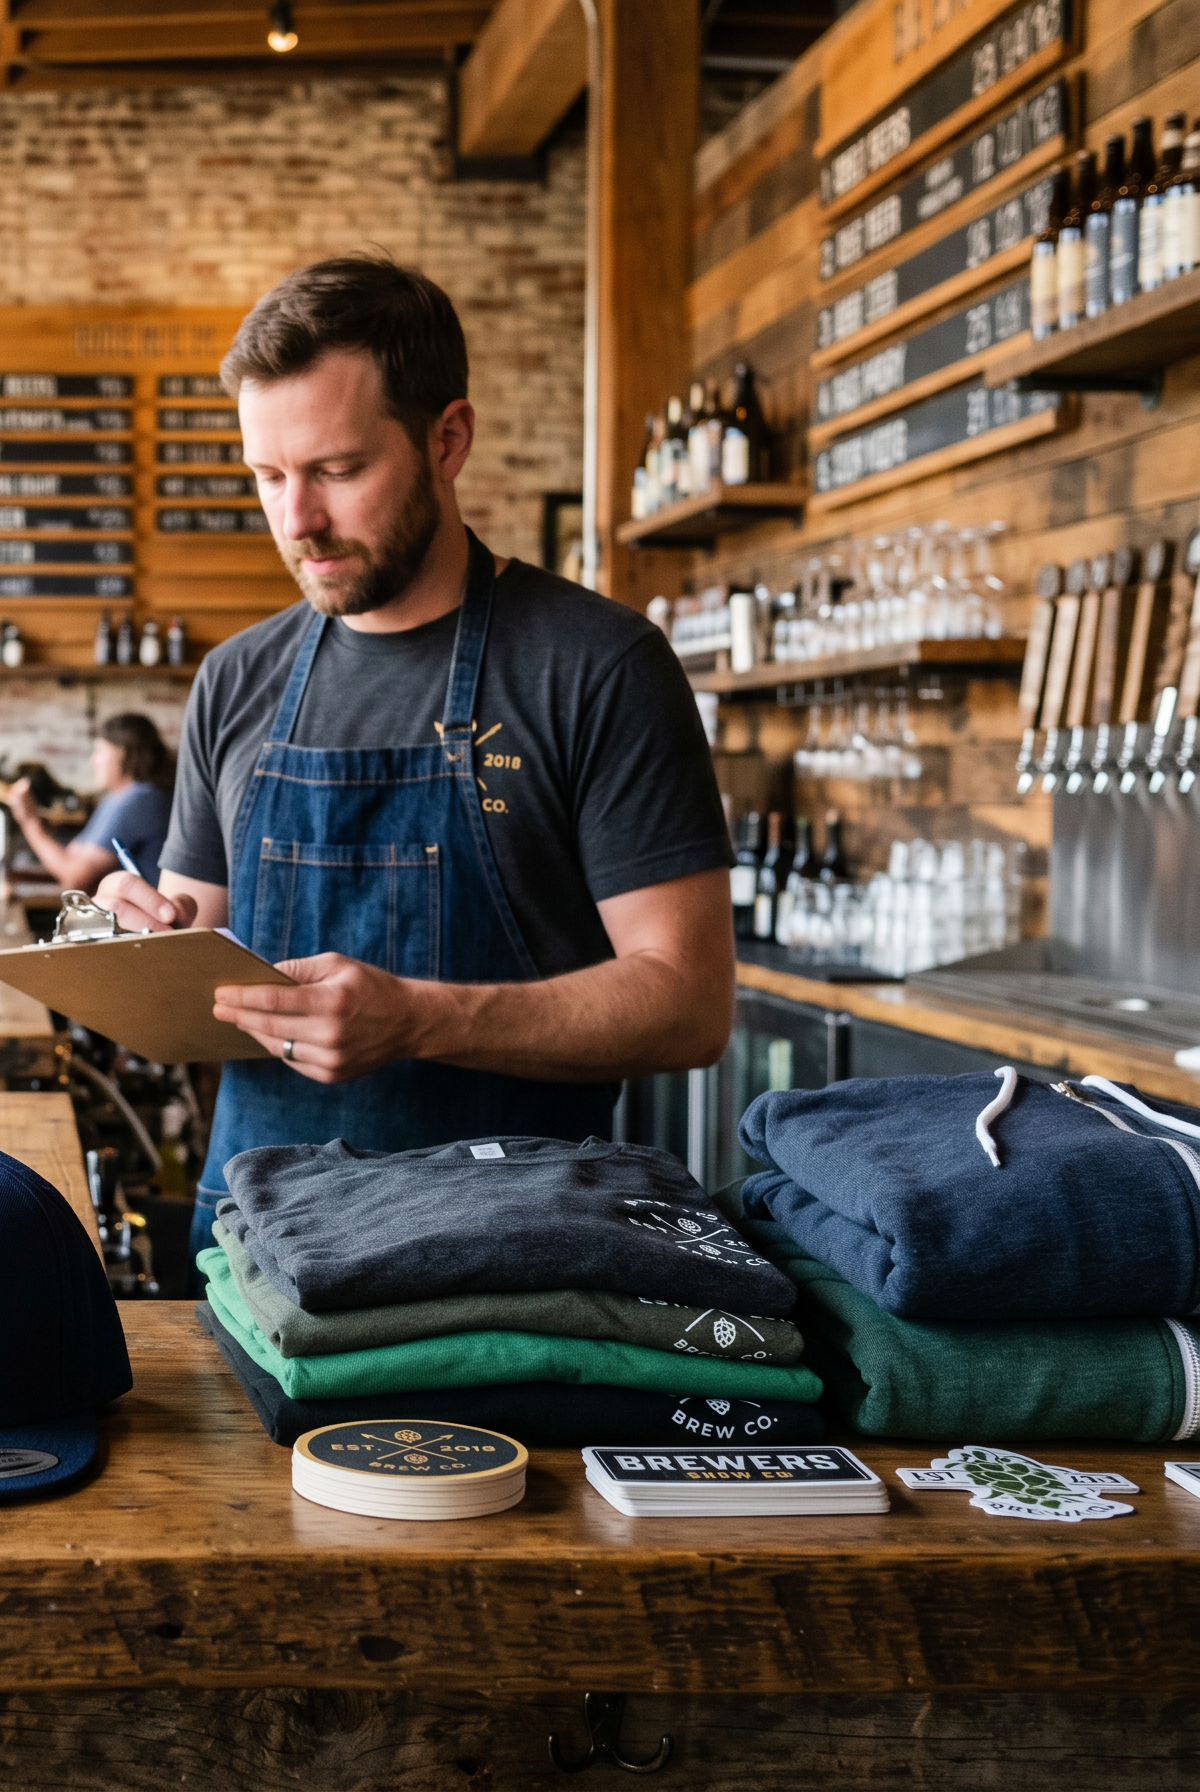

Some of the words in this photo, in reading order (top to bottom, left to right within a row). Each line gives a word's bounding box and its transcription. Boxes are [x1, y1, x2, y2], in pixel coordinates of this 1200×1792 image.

[483, 752, 522, 770] 2018
[481, 797, 509, 814] CO.
[671, 1409, 735, 1439] BREW
[744, 1415, 779, 1436] CO.
[331, 1443, 382, 1452] EST.
[440, 1445, 496, 1453] 2018
[368, 1461, 431, 1472] BREW
[439, 1462, 472, 1471] CO.
[614, 1454, 841, 1472] BREWERS
